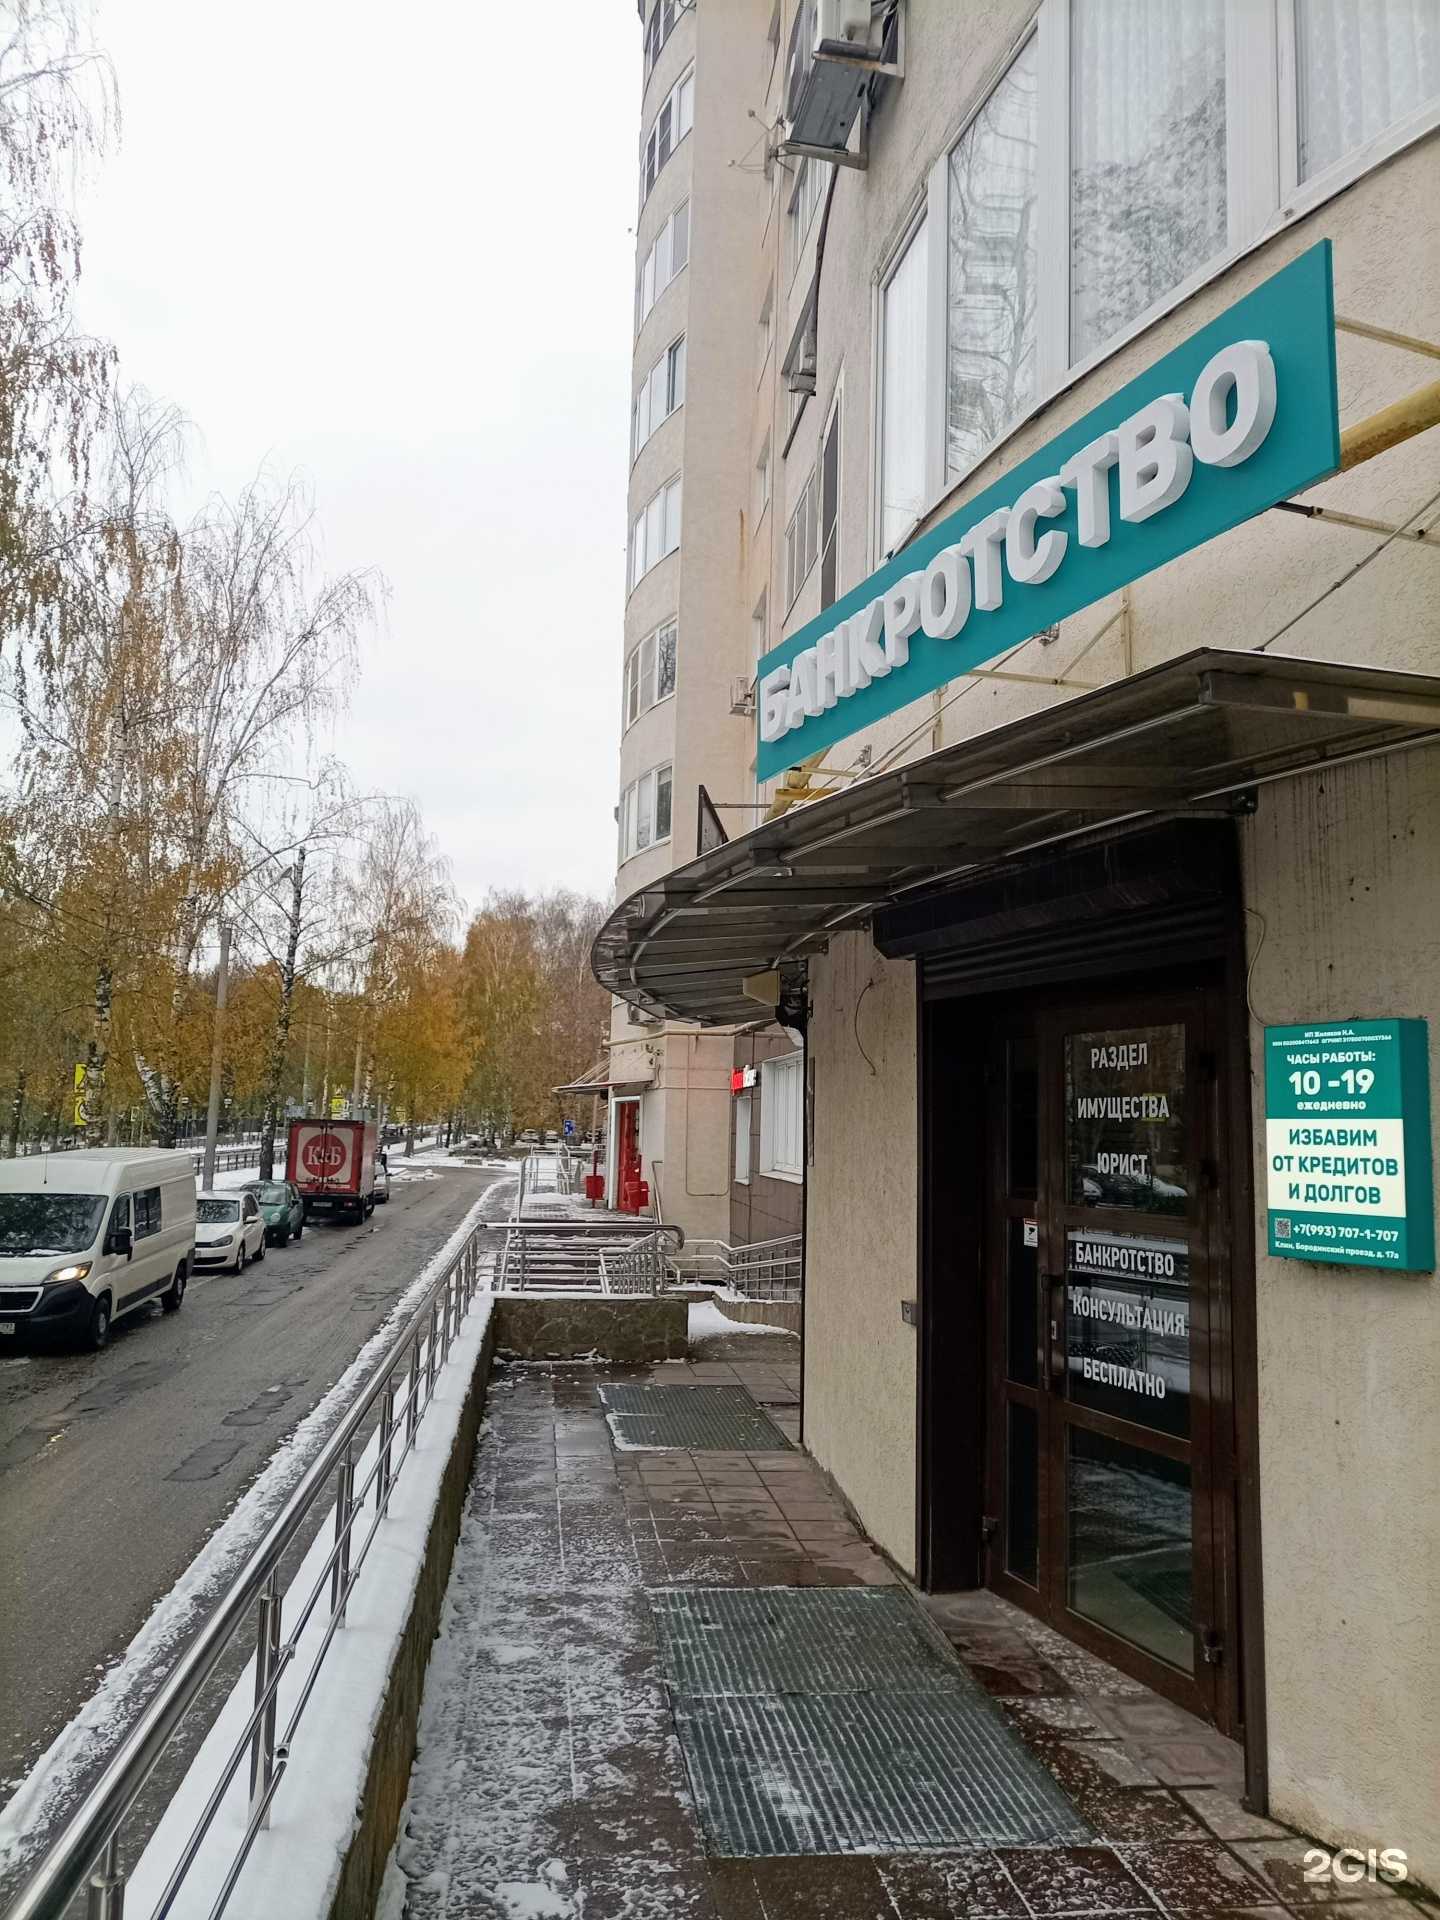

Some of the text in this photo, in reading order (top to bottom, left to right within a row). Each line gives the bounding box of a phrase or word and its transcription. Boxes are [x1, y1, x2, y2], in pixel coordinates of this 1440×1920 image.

[760, 339, 1277, 743] БАНКРОТСТВО
[1091, 1042, 1148, 1071] РАЗДЕЛ
[1286, 1051, 1376, 1064] ЧАСЫ РАБОТЫ:
[1289, 1071, 1321, 1095] 10
[1077, 1095, 1169, 1121] ИМУЩЕСТВА
[1296, 1100, 1366, 1111] ежедневно
[1289, 1128, 1377, 1146] ИЗБАВИМ
[1097, 1152, 1148, 1177] ЮРИСТ
[1272, 1155, 1398, 1176] ОТ КРЕДИТОВ
[1288, 1182, 1381, 1204] И ДОЛГОВ
[1293, 1223, 1399, 1242] +7(993) 707-1-707
[1075, 1241, 1175, 1276] БАНКРОТСТВО
[1072, 1293, 1186, 1337] КОНСУЛЬТАЦИЯ
[1083, 1357, 1167, 1399] БЕСПЛАТНО
